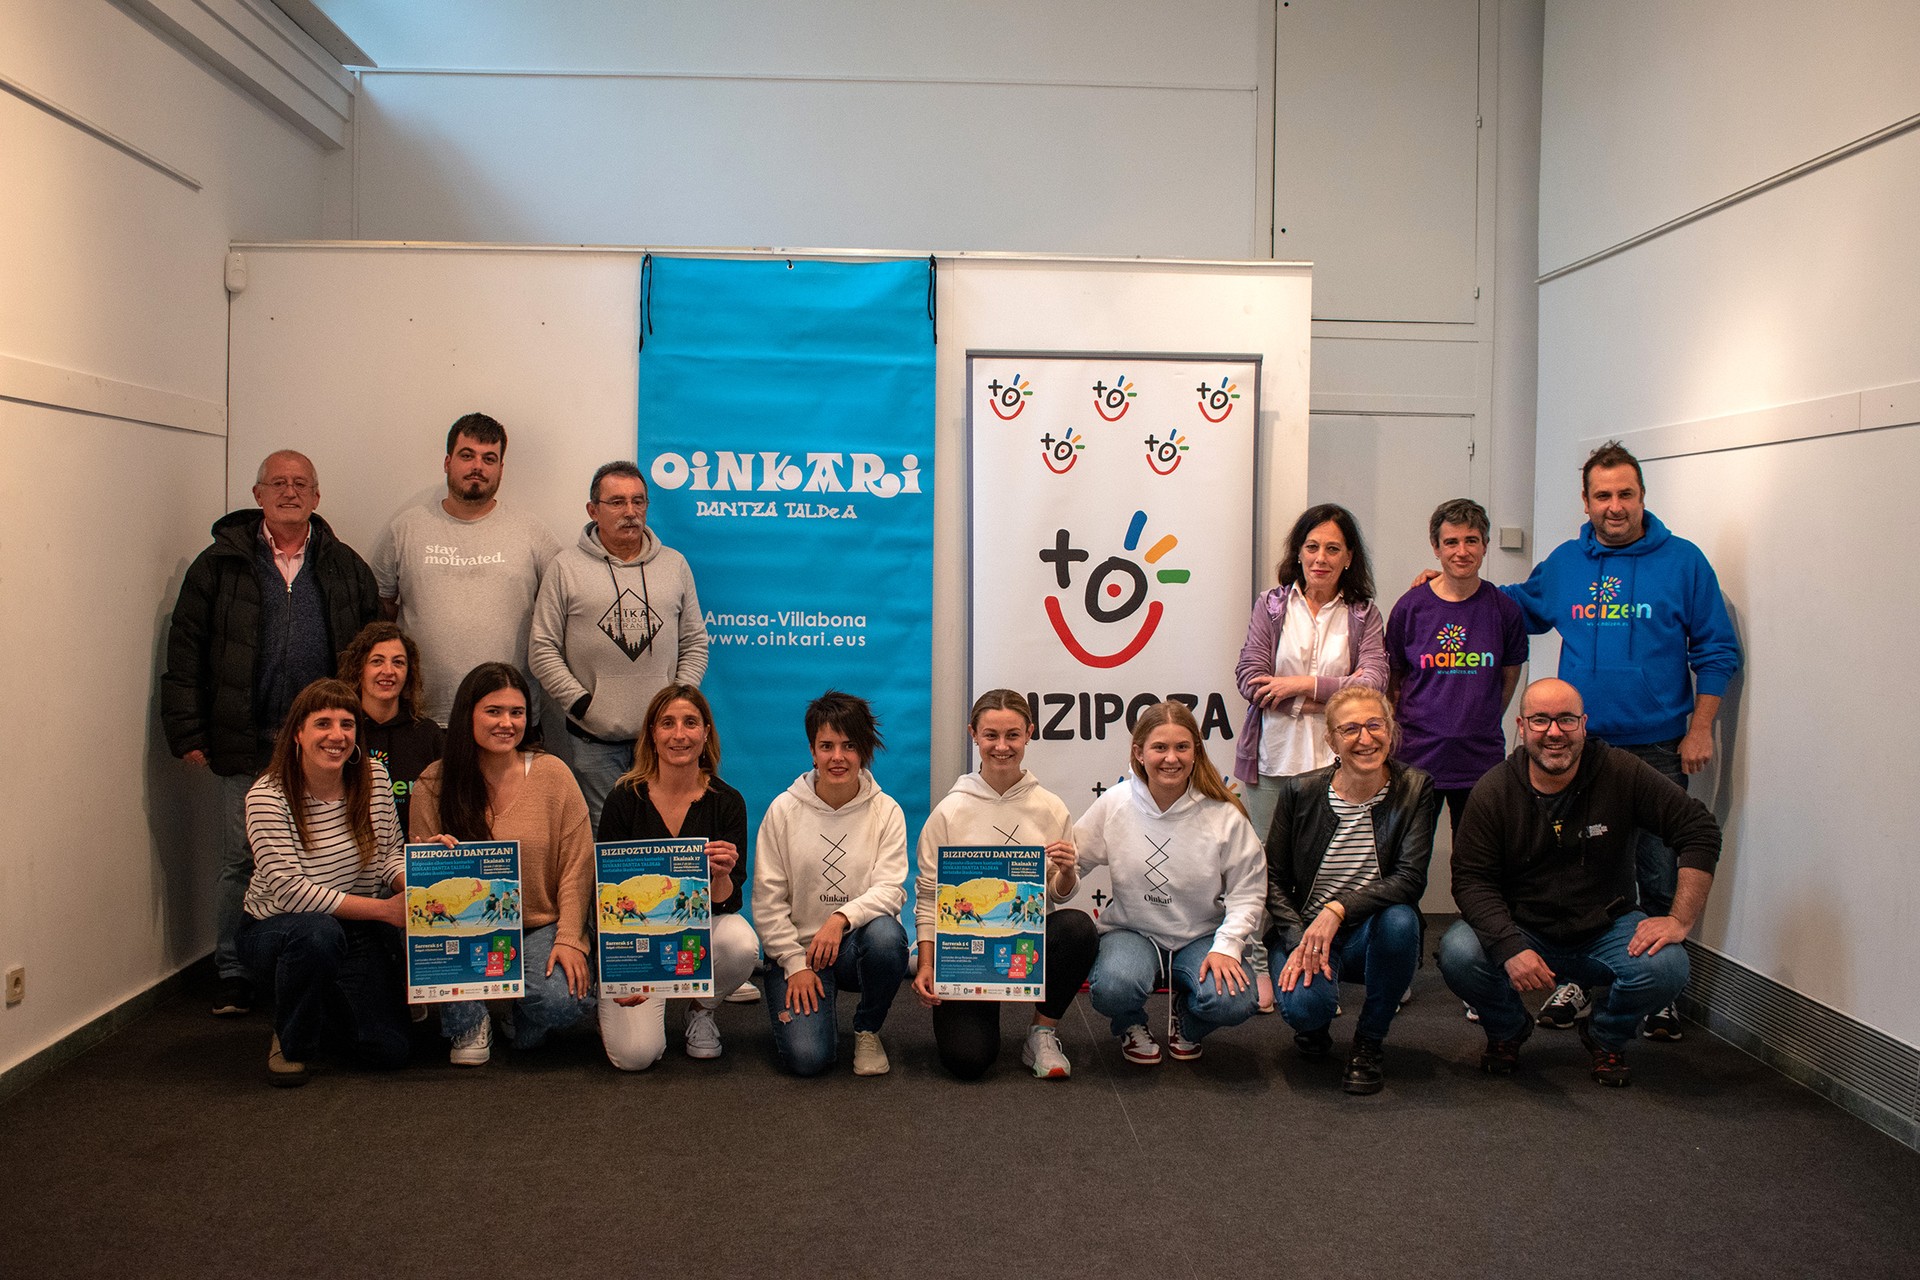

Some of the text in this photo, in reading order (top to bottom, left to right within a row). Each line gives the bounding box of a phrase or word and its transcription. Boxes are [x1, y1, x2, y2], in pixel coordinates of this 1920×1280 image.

[696, 501, 778, 518] DANTZA
[425, 544, 458, 556] stay
[424, 552, 506, 566] motivated.
[704, 610, 866, 628] Amasa-Villabona
[708, 632, 866, 646] www.oinkari.eus
[1420, 652, 1494, 669] naizen
[410, 848, 513, 859] BIZIPOZTU DANTZAN!
[601, 845, 702, 856] BIZIPOZTU DANTZAN!
[820, 894, 849, 902] Oinkari
